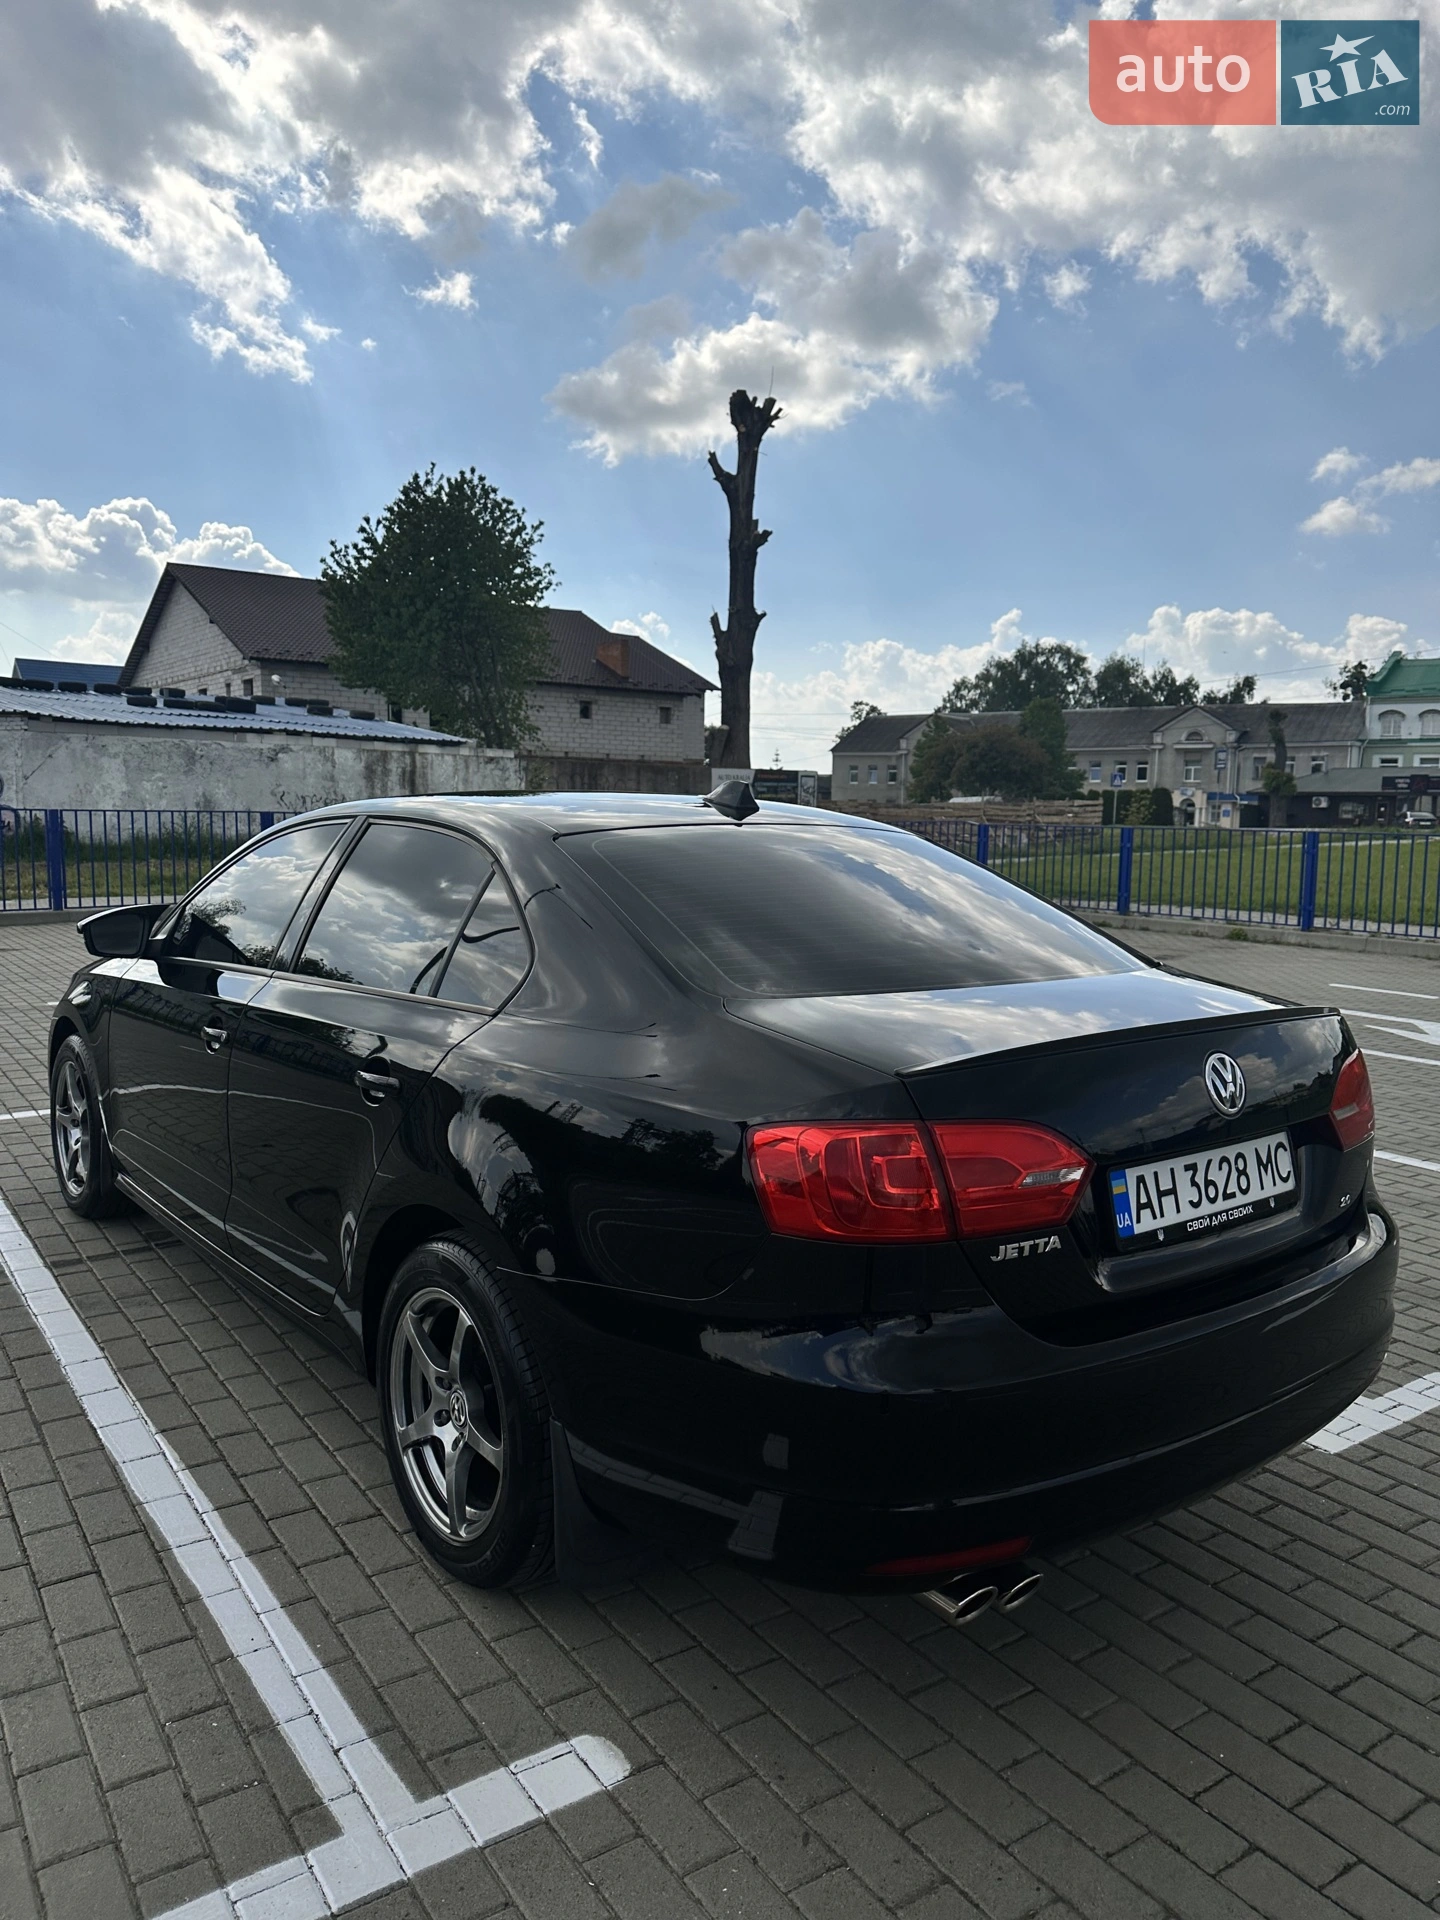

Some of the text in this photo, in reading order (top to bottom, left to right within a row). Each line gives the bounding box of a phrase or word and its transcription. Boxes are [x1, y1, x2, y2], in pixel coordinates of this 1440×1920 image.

[1135, 1141, 1291, 1224] AH 3628 MC
[1116, 1212, 1132, 1229] UA
[1186, 1204, 1254, 1231] СВОЙ ДЛЯ СВОИХ
[990, 1235, 1061, 1262] JETTA
